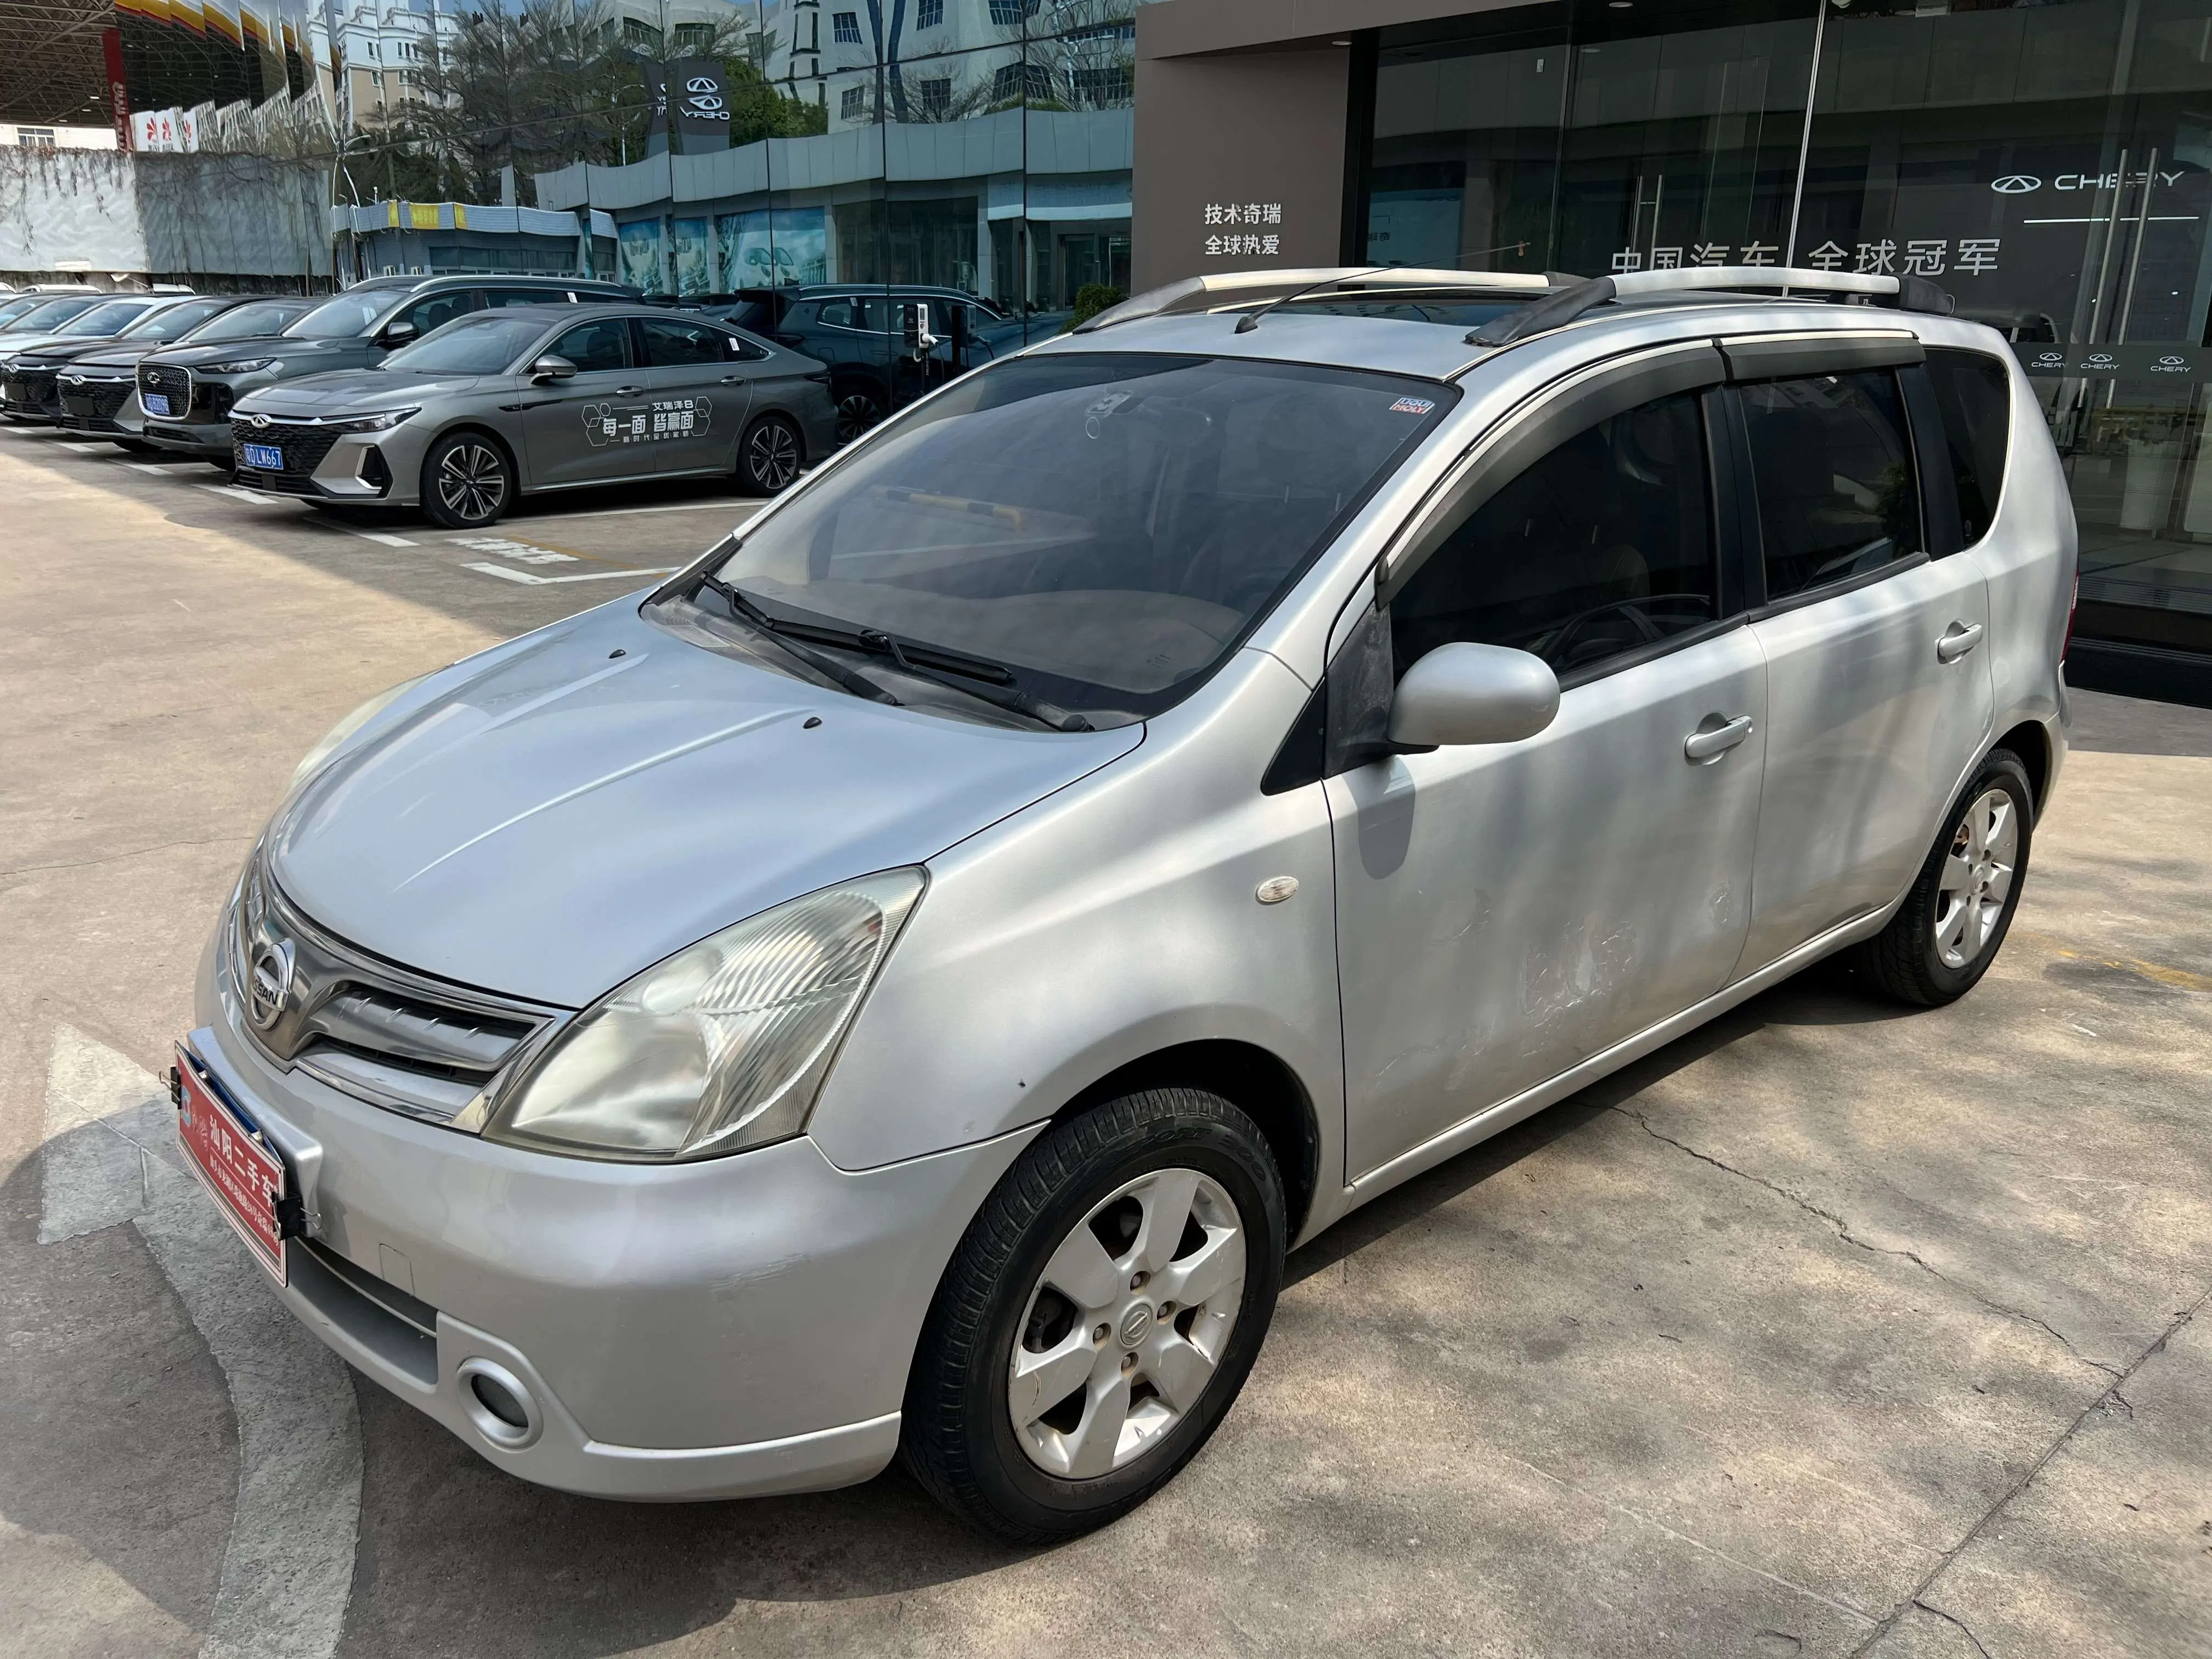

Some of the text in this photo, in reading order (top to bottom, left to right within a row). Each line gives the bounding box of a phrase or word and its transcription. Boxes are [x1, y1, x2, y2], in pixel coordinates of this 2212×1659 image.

[2055, 171, 2186, 190] CHERY
[1204, 203, 1282, 225] 技术奇瑞
[1204, 234, 1280, 256] 全球热爱
[1612, 238, 2001, 276] 中国汽车 全球冠军
[652, 399, 694, 411] 艾瑞泽8
[1393, 404, 1426, 413] MOLY
[1399, 398, 1432, 408] LIQUI
[603, 410, 694, 437] 每一面 皆赢面
